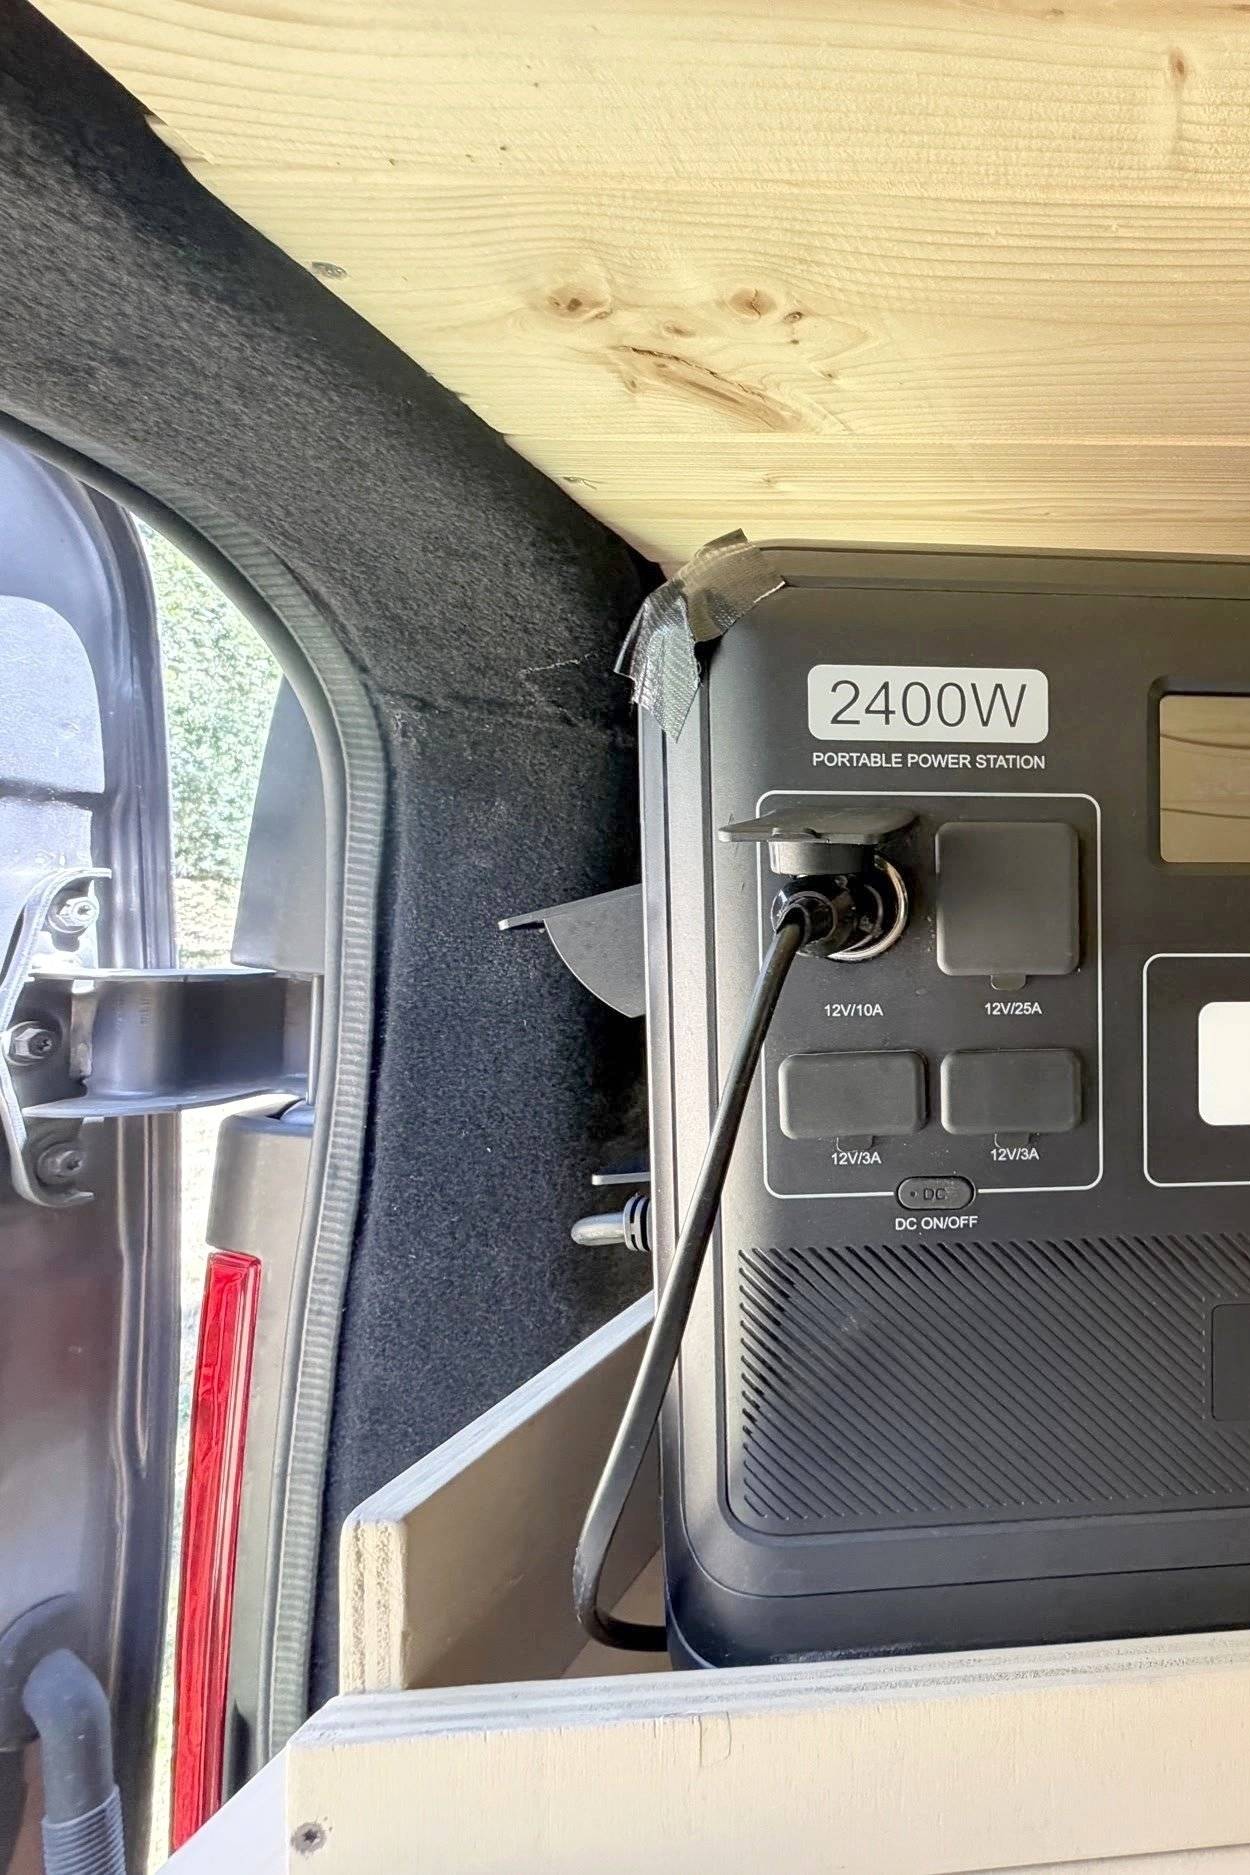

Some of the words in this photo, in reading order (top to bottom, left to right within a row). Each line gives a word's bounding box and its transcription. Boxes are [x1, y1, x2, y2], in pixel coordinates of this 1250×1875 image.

[830, 679, 1027, 728] 2400W
[812, 752, 903, 768] PORTABLE
[907, 753, 972, 769] POWER
[975, 754, 1046, 770] STATION
[824, 1003, 884, 1017] 12V/10A
[984, 1001, 1043, 1015] 12V/25A
[831, 1151, 882, 1165] 12V/3A
[990, 1147, 1040, 1161] 12V/3A
[895, 1217, 917, 1231] DC
[920, 1215, 979, 1230] ON/OFF
